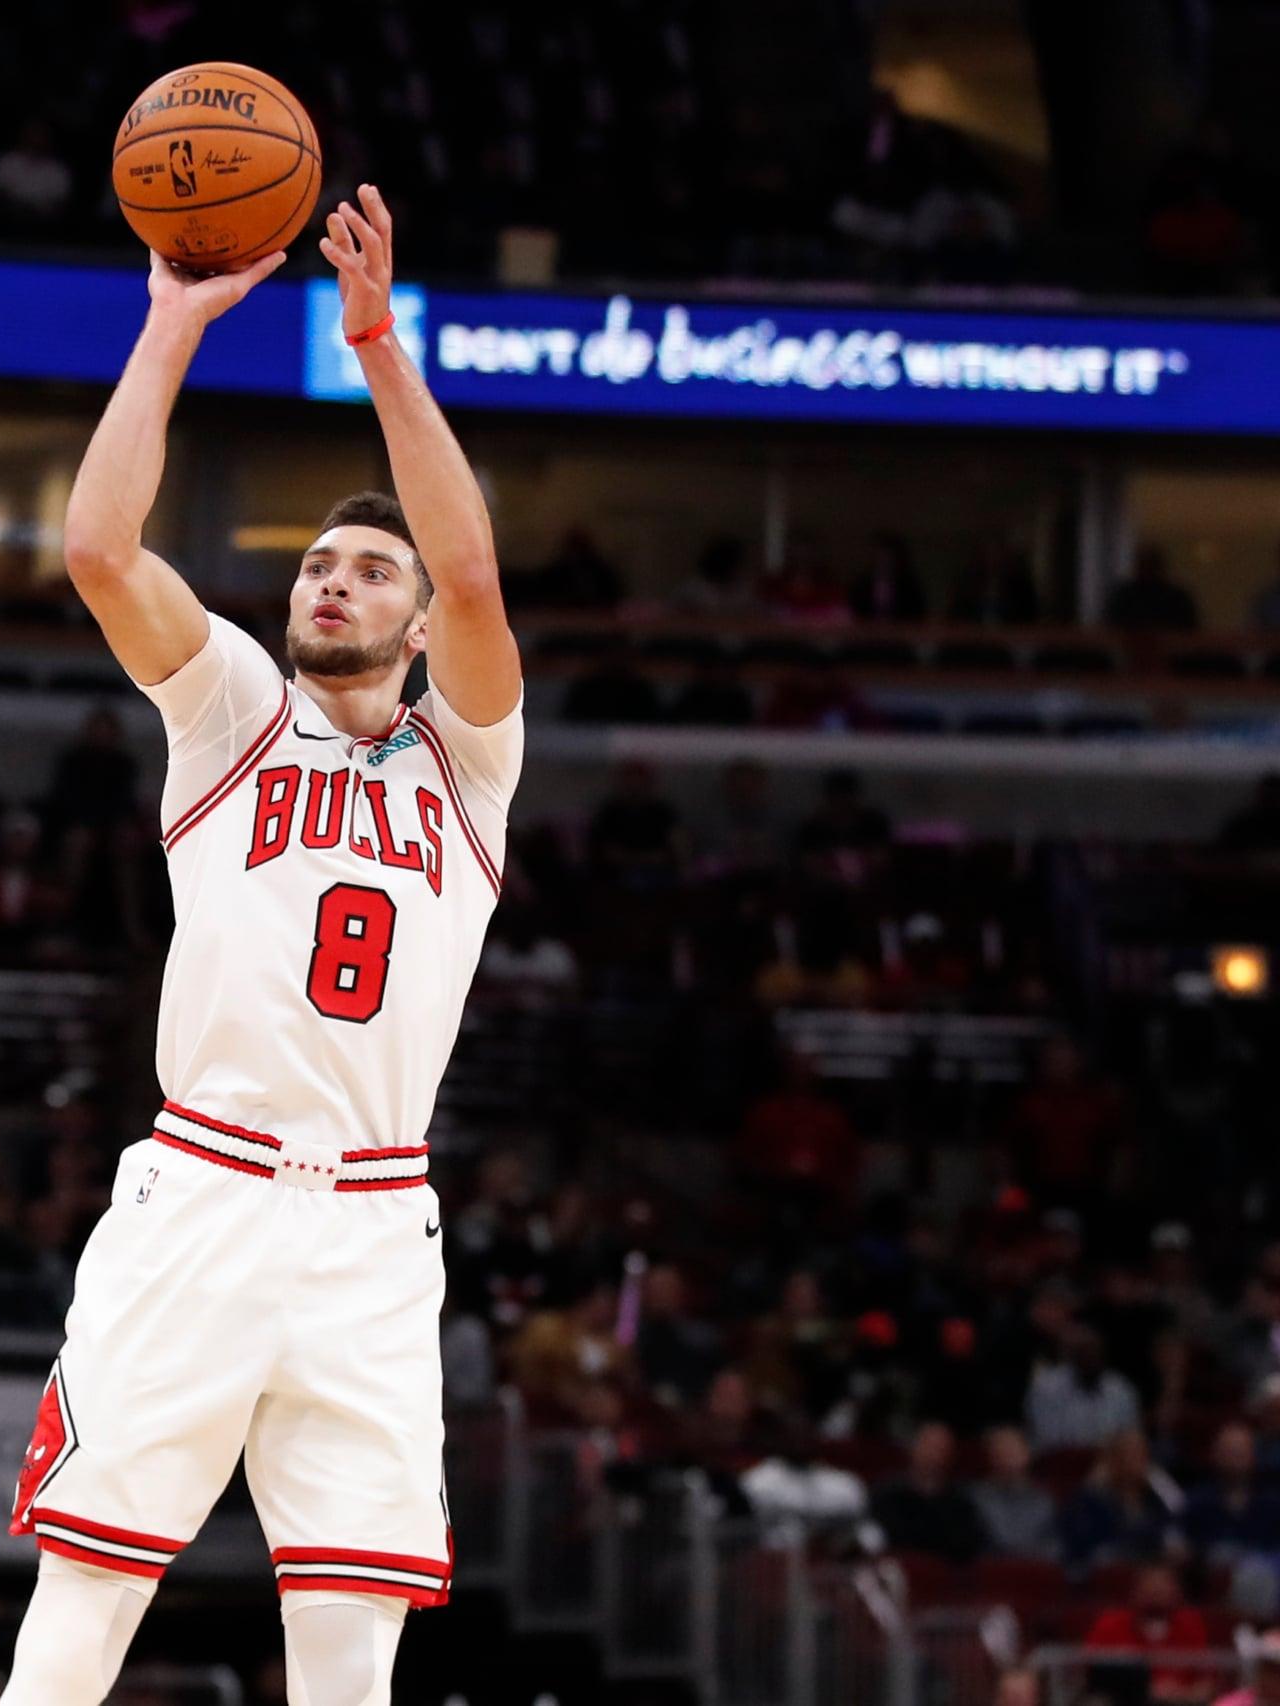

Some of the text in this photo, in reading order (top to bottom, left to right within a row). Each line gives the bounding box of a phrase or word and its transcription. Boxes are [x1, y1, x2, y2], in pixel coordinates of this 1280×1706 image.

[123, 86, 257, 137] SPALDING
[437, 321, 580, 375] DON'T
[581, 295, 655, 384] do
[903, 341, 1112, 394] WITHOUT
[245, 764, 443, 898] BULLS
[306, 881, 397, 1024] 8
